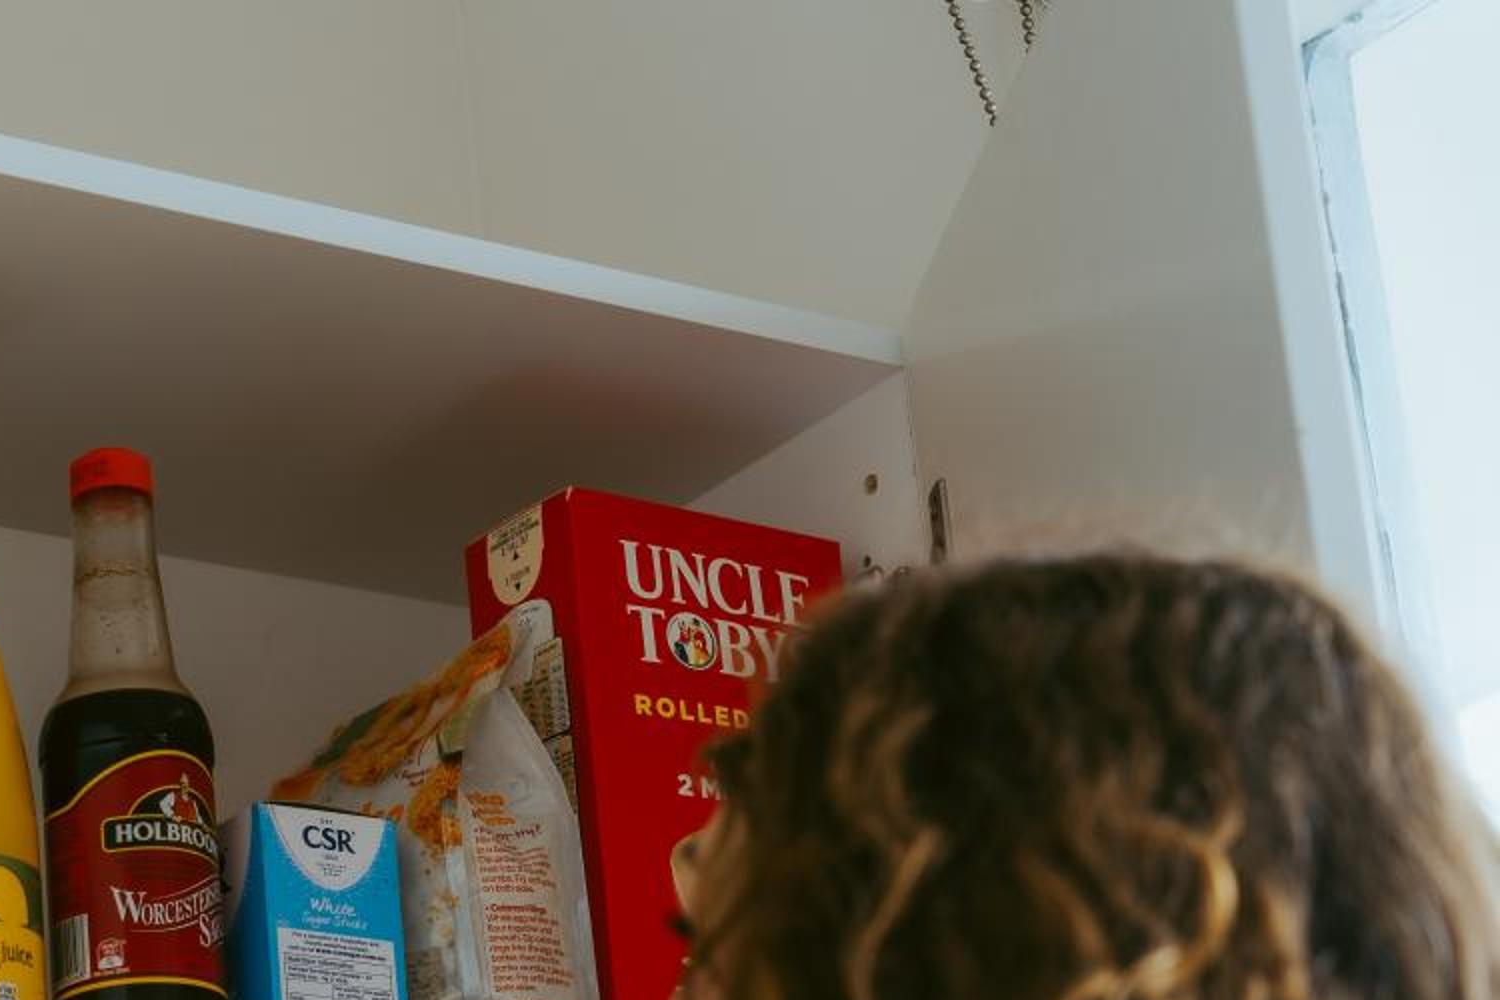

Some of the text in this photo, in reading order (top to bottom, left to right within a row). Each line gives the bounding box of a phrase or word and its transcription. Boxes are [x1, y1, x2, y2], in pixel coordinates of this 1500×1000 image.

[619, 540, 809, 626] UNCLE
[634, 694, 751, 730] ROLLED
[676, 773, 695, 798] 2
[302, 826, 356, 855] CSR
[1, 942, 34, 970] juice
